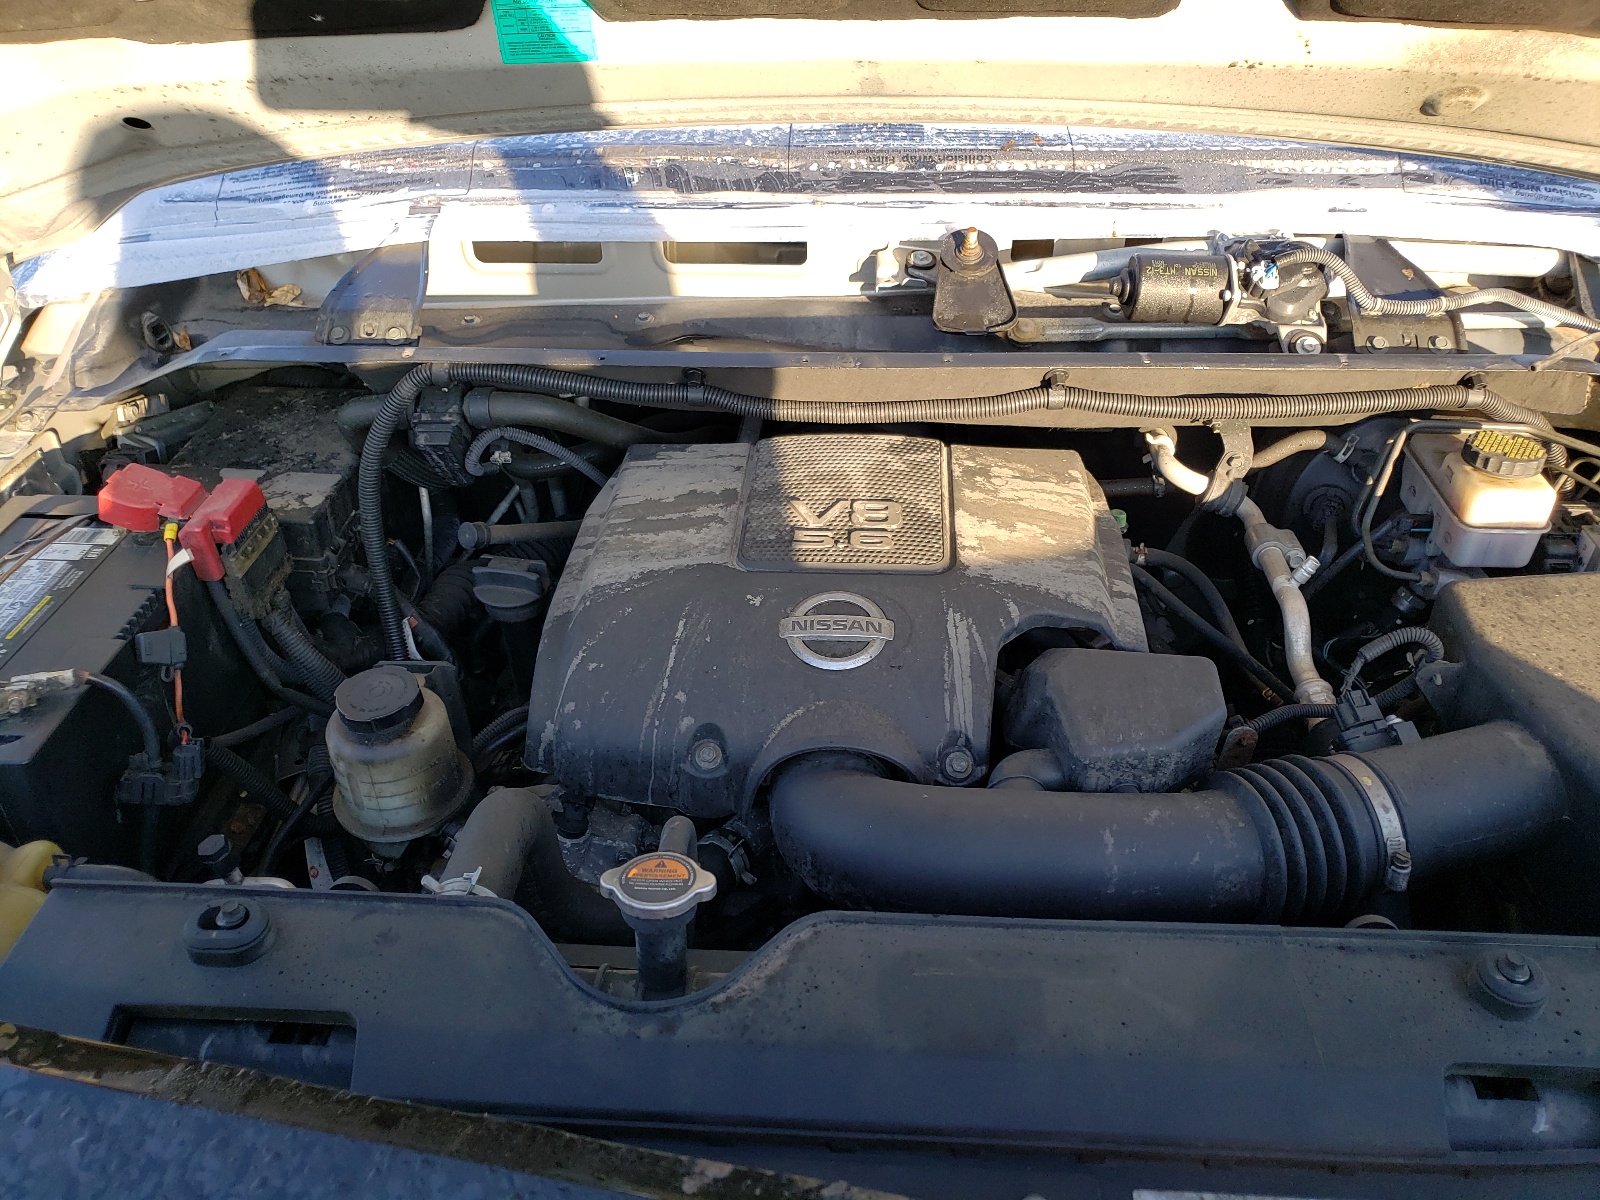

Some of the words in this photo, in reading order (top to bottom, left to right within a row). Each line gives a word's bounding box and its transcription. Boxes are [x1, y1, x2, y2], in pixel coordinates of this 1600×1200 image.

[868, 155, 895, 164] Film
[901, 153, 934, 164] Wrap
[937, 154, 992, 164] Collision
[1510, 181, 1541, 192] Wrap
[1544, 187, 1595, 201] Collision
[1185, 267, 1218, 276] NISSAN
[789, 499, 902, 528] V8
[793, 529, 894, 550] 5.6
[790, 618, 883, 634] NISSAN
